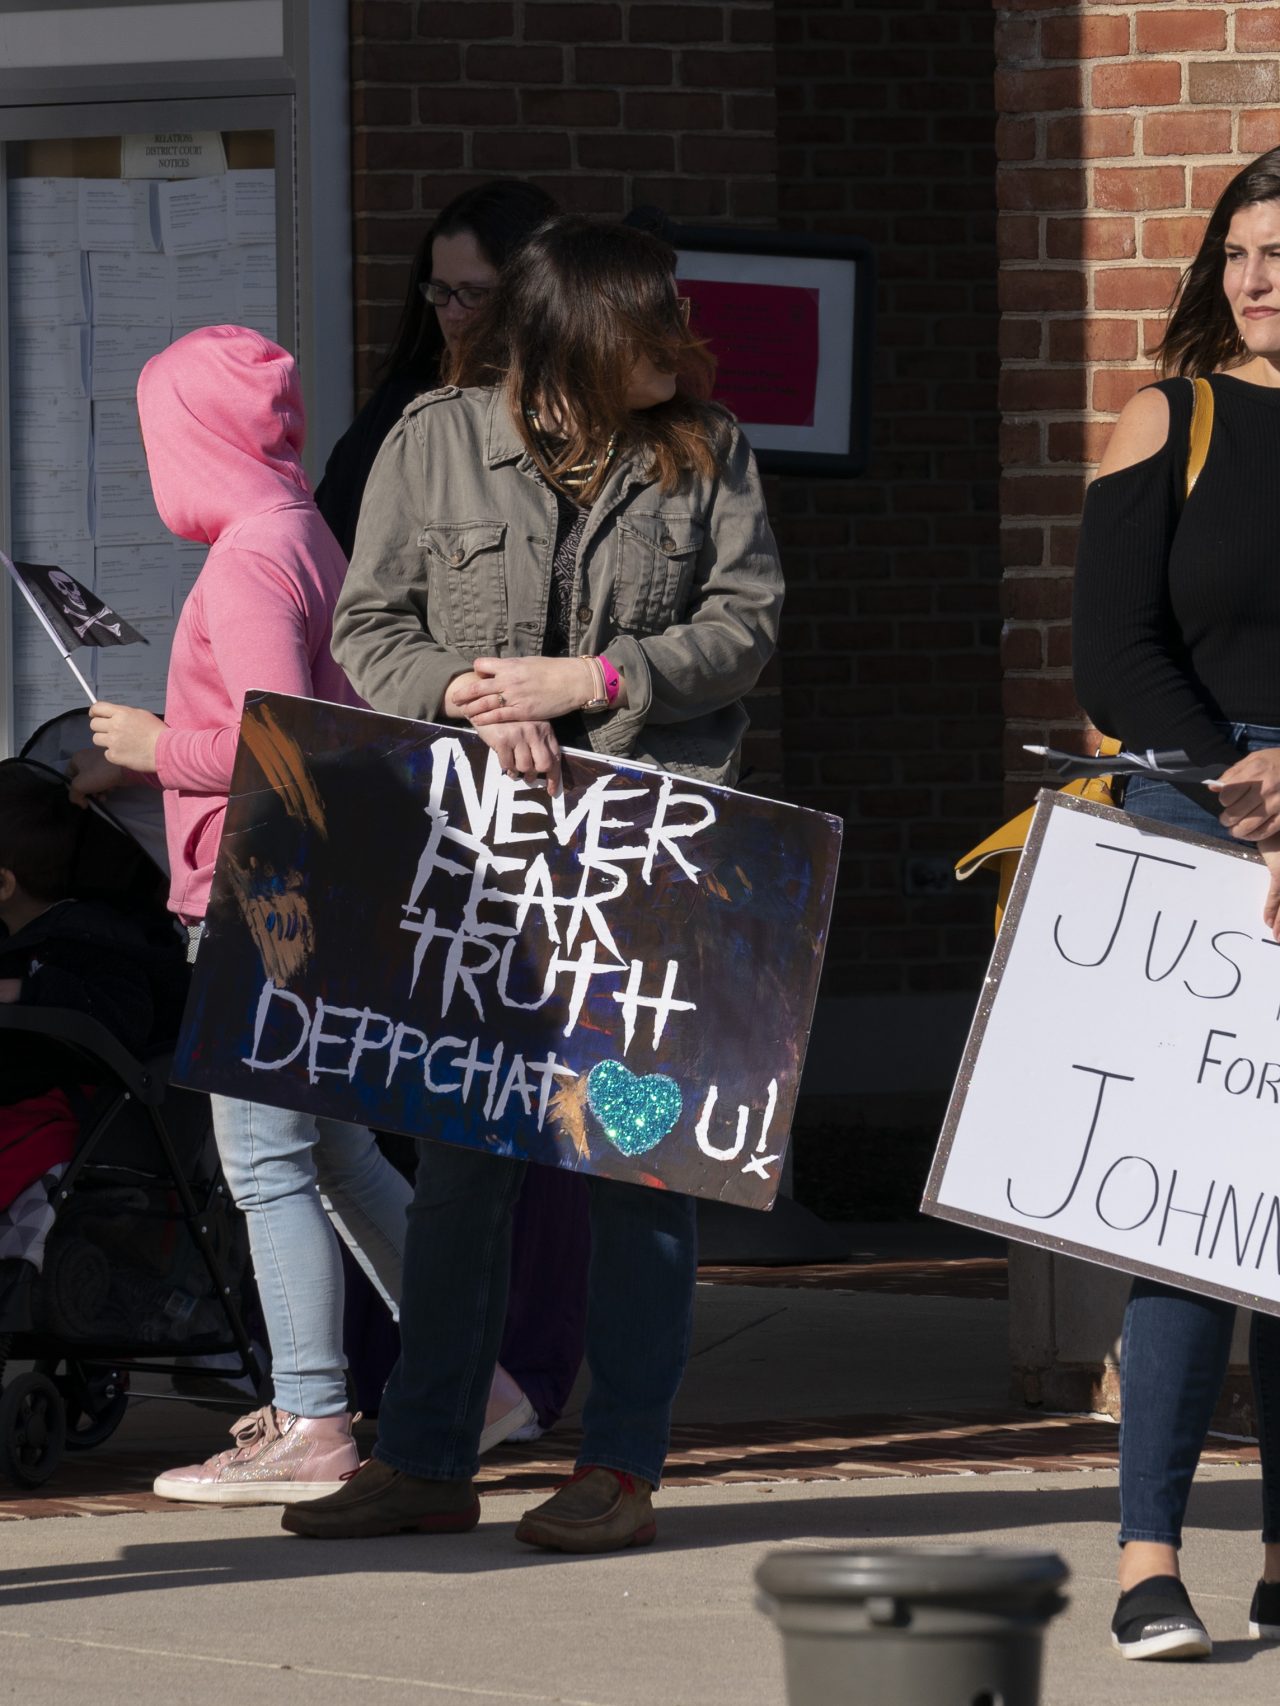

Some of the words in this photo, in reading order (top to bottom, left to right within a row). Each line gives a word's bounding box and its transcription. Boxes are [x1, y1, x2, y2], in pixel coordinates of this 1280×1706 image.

[145, 145, 178, 157] DISTRICT
[178, 144, 203, 156] COURT
[158, 158, 191, 169] NOTICES
[426, 737, 716, 886] NEVER
[403, 815, 628, 968] FEAR
[241, 979, 577, 1133] DEPPCHAT
